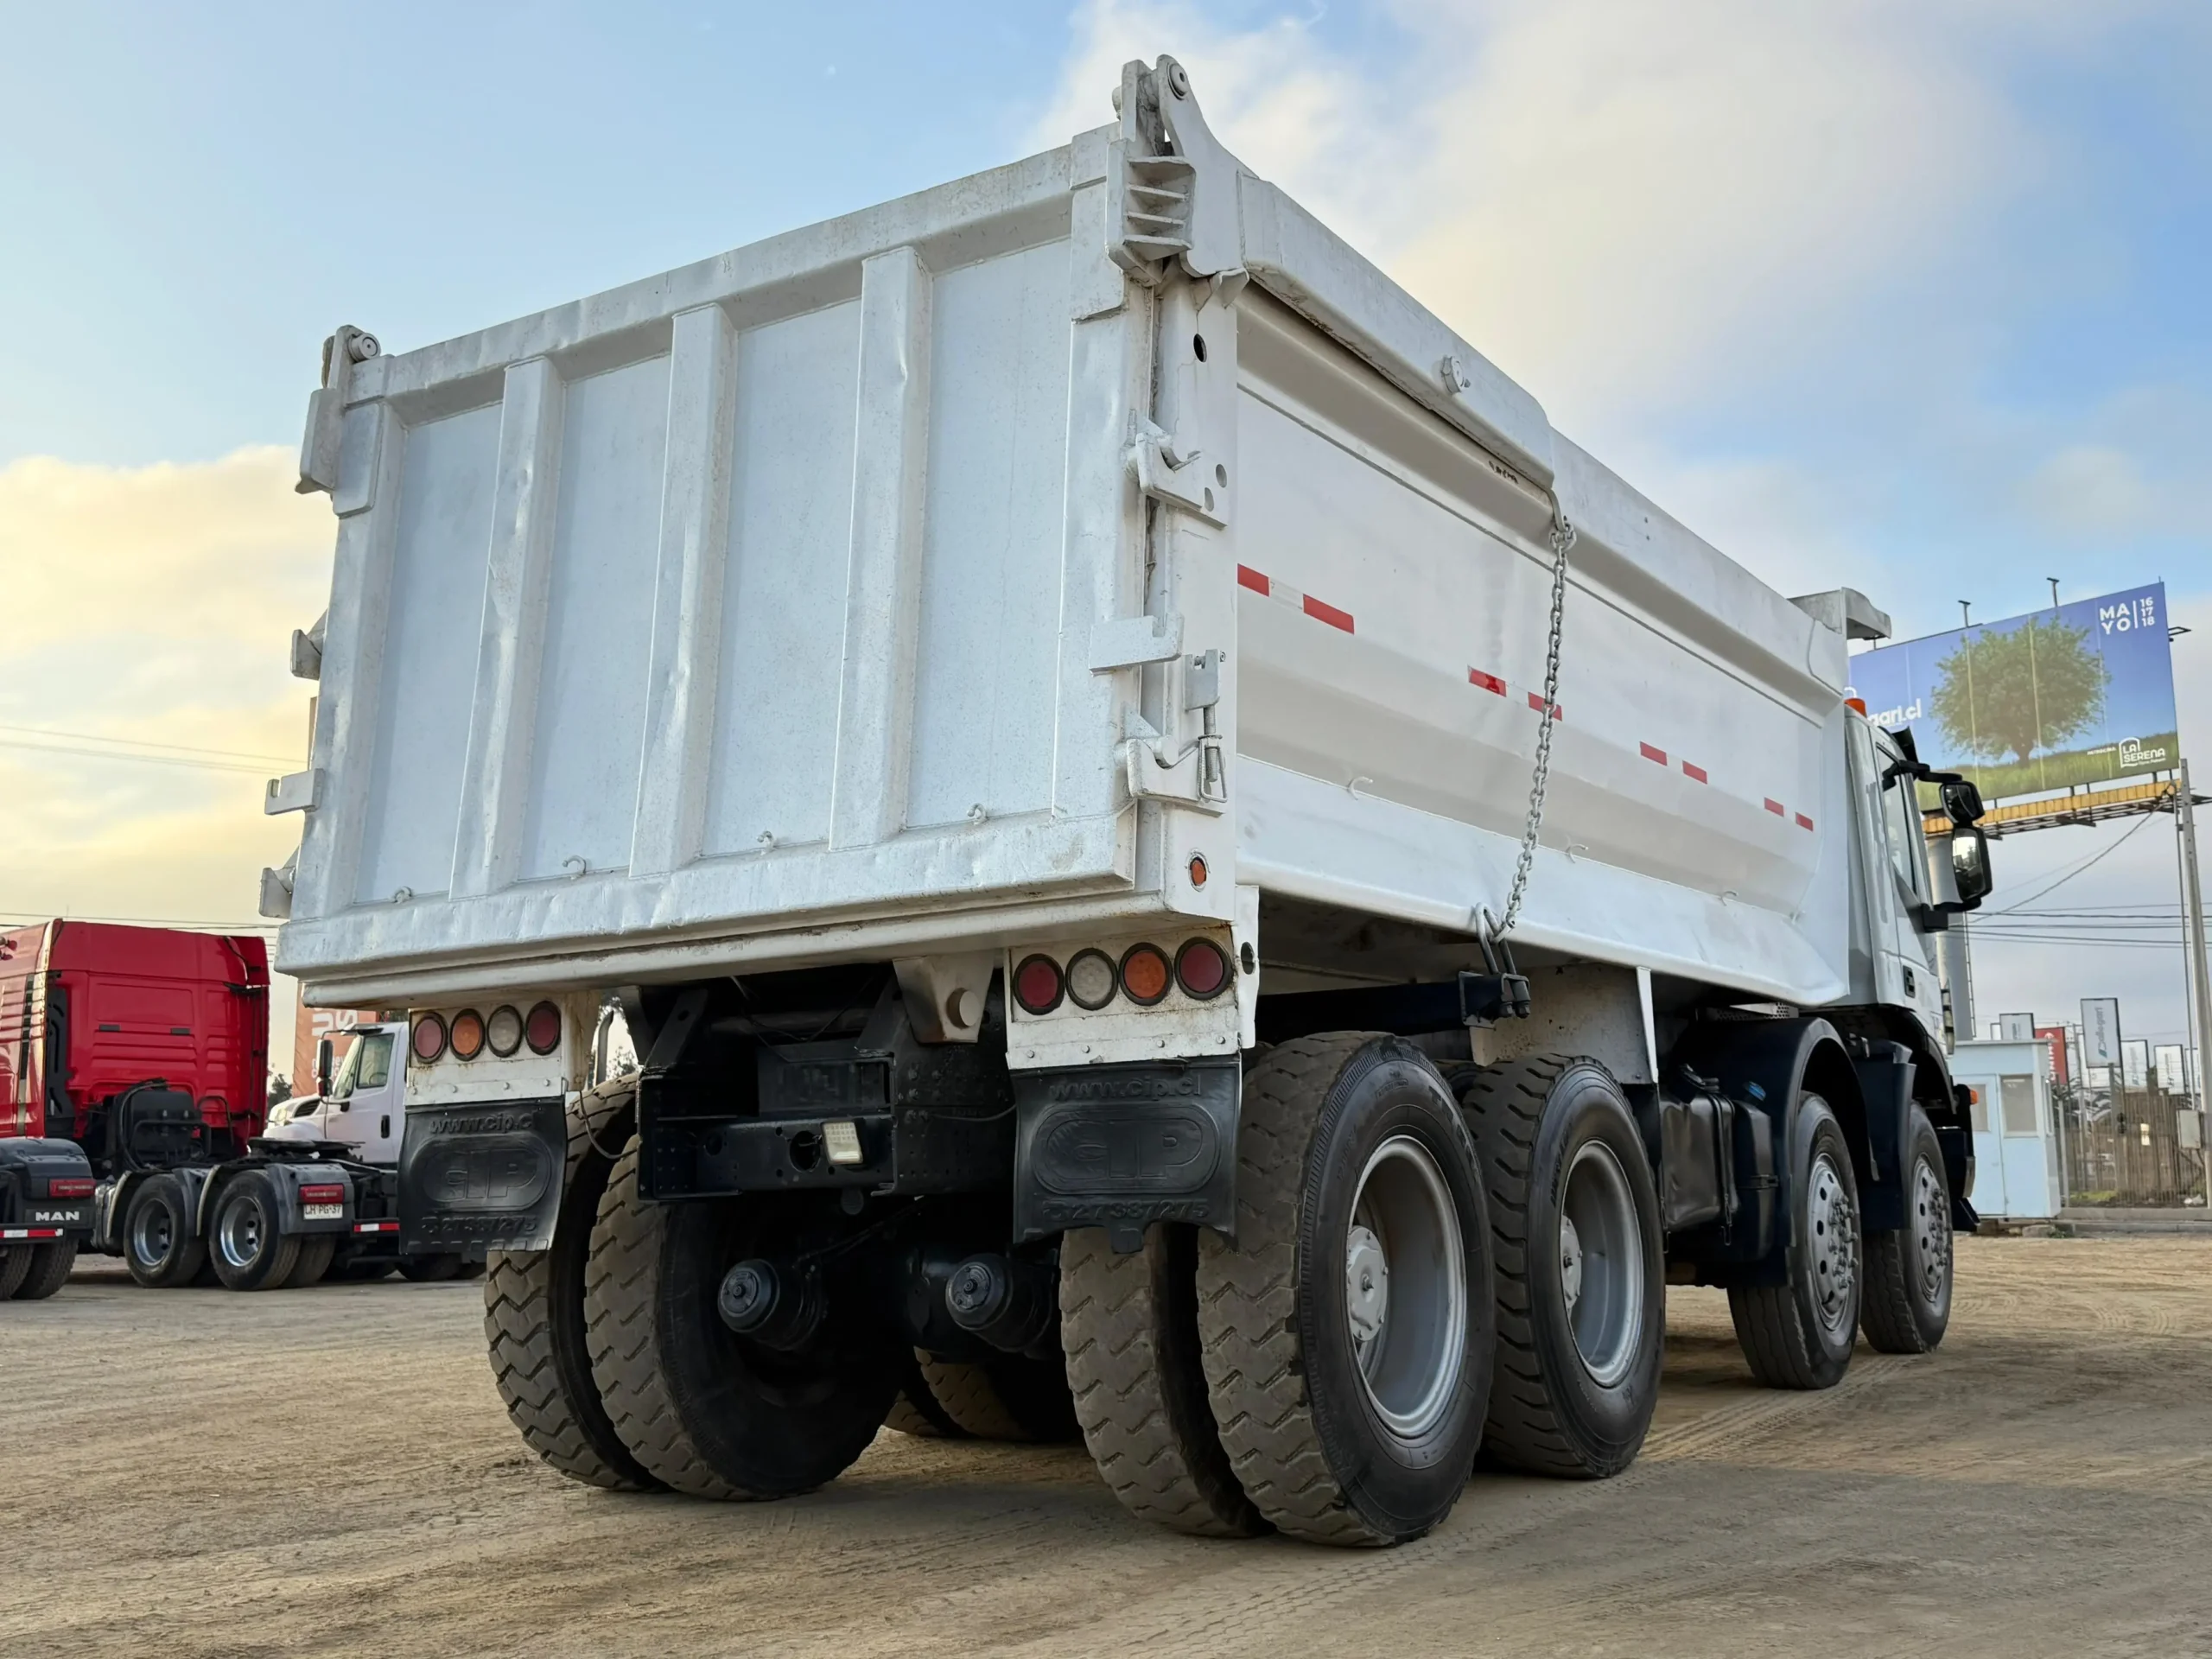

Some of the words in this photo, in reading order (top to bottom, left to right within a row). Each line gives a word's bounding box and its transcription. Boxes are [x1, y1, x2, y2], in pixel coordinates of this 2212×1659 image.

[2139, 596, 2154, 607] 16
[2099, 602, 2131, 621] MA
[2140, 607, 2154, 617] 17
[2101, 617, 2132, 635] YO
[2141, 616, 2156, 627] 18
[2122, 744, 2137, 754] LA
[2123, 747, 2166, 763] SERENA
[1048, 1074, 1202, 1102] www.cip.cl
[430, 1109, 537, 1135] www.cip.c
[35, 1211, 79, 1221] MAN
